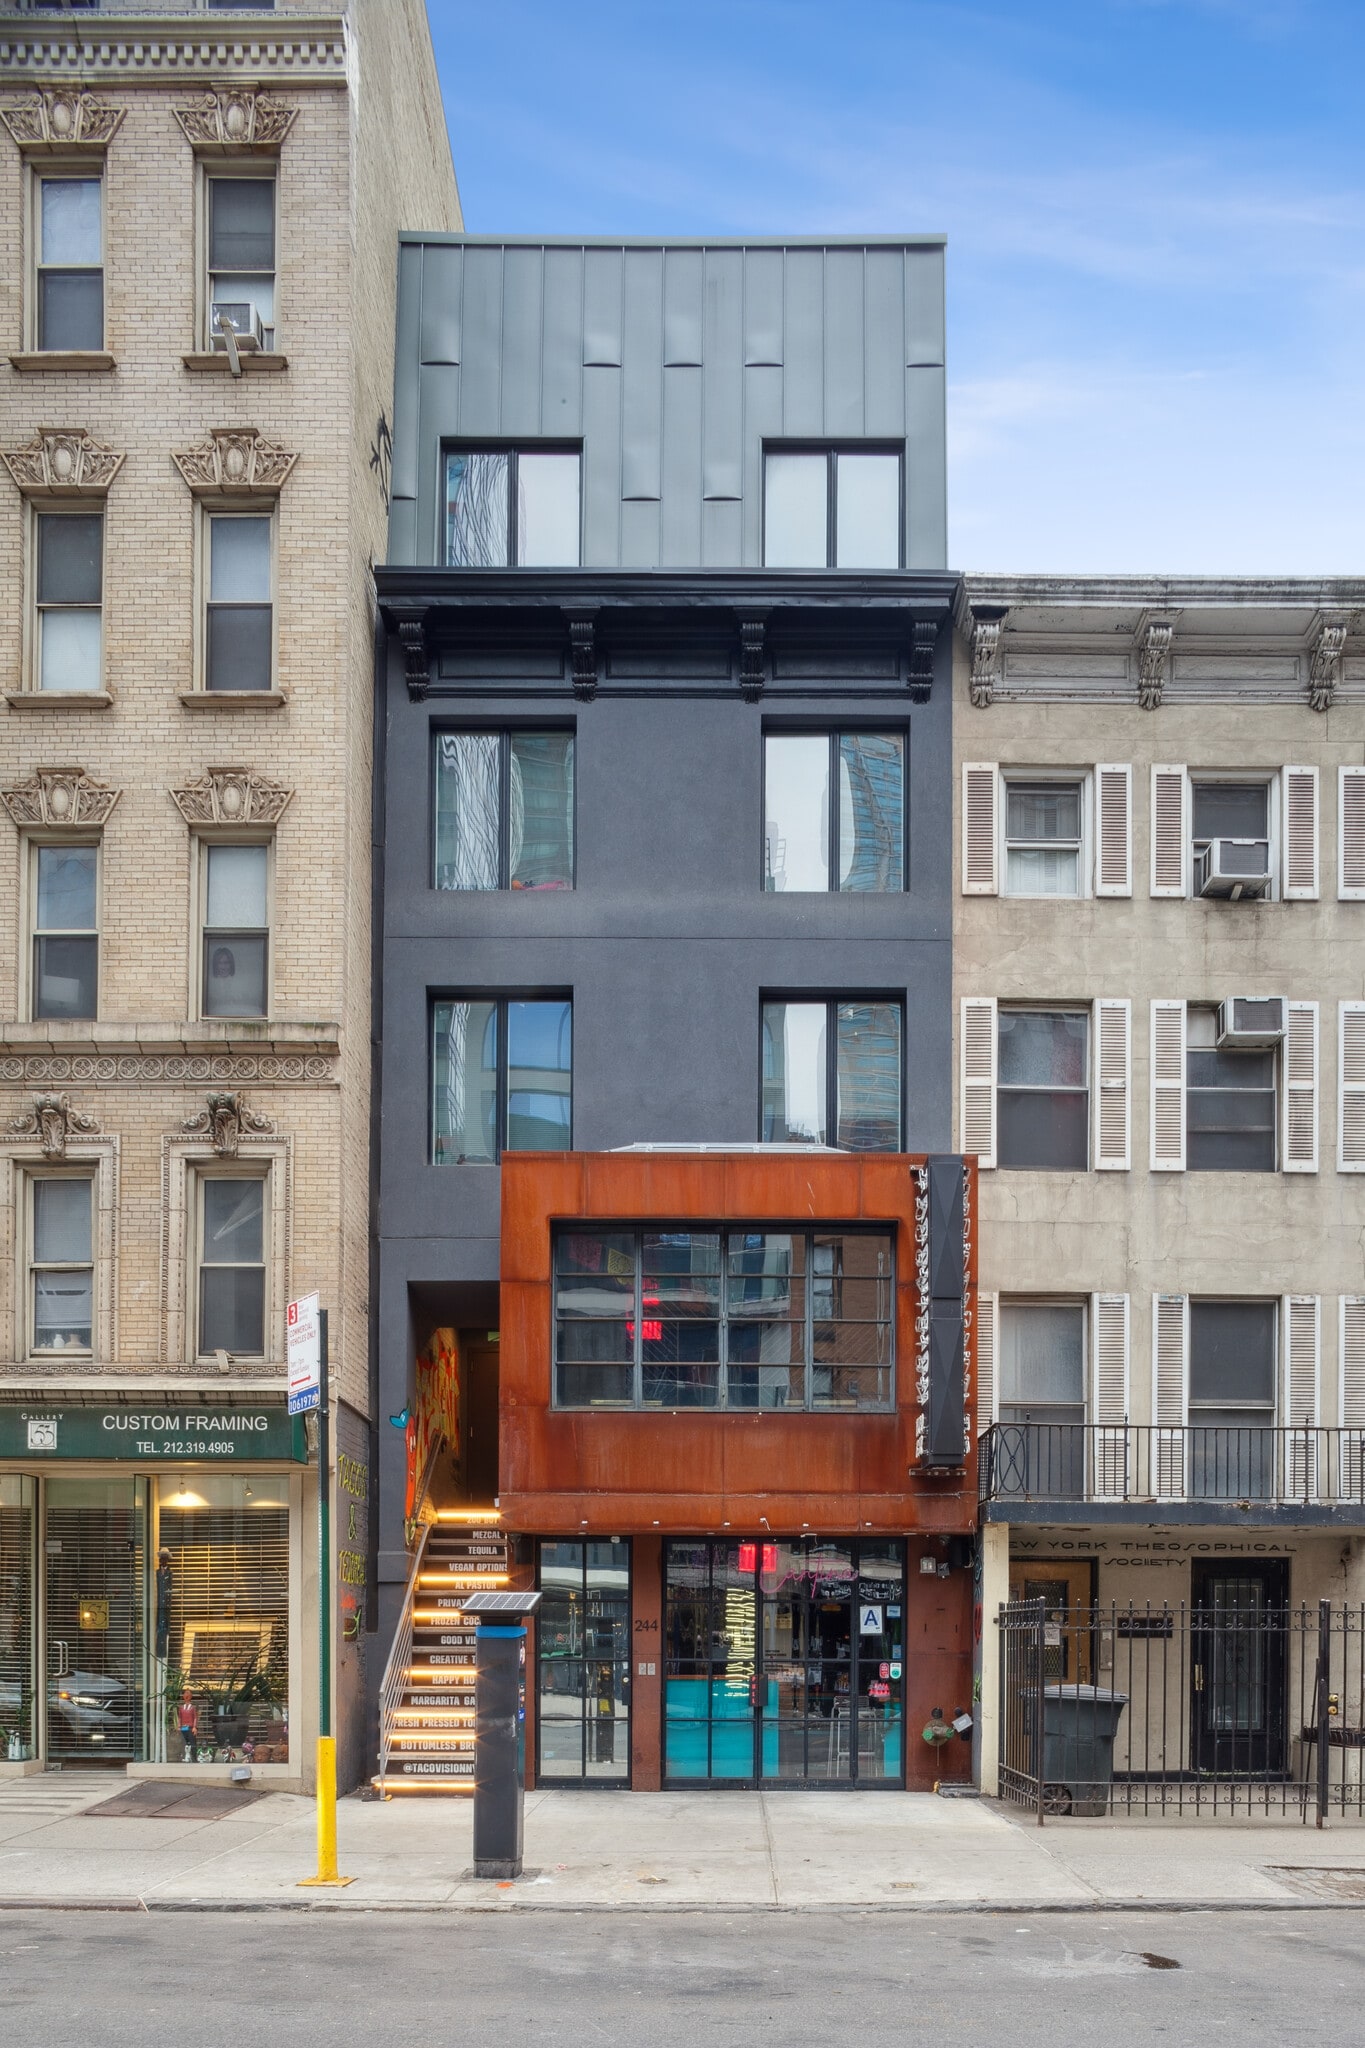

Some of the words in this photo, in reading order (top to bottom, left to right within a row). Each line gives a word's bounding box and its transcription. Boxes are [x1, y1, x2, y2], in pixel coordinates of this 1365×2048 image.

[290, 1305, 296, 1323] 3
[102, 1415, 180, 1431] CUSTOM
[185, 1416, 268, 1431] FRAMING
[136, 1441, 160, 1453] TEL.
[163, 1441, 235, 1454] 212.319.4905
[472, 1531, 501, 1539] MEZCAL
[468, 1546, 498, 1555] TEQUILA
[1048, 1542, 1108, 1550] YORK
[1120, 1542, 1297, 1552] THEOSOPHICAL
[449, 1563, 474, 1572] VEGAN
[1103, 1558, 1188, 1567] SOCIETY
[455, 1582, 464, 1590] AL
[466, 1582, 497, 1590] PASTOR
[431, 1616, 460, 1625] FROZEN
[864, 1610, 878, 1626] A
[634, 1619, 658, 1632] 244
[440, 1635, 463, 1645] GOOD
[429, 1655, 468, 1664] CREATIVE
[432, 1675, 460, 1684] HAPPY
[410, 1695, 460, 1705] MARGARITA
[422, 1717, 460, 1727] PRESSED
[400, 1740, 457, 1750] BOTTOMLESS
